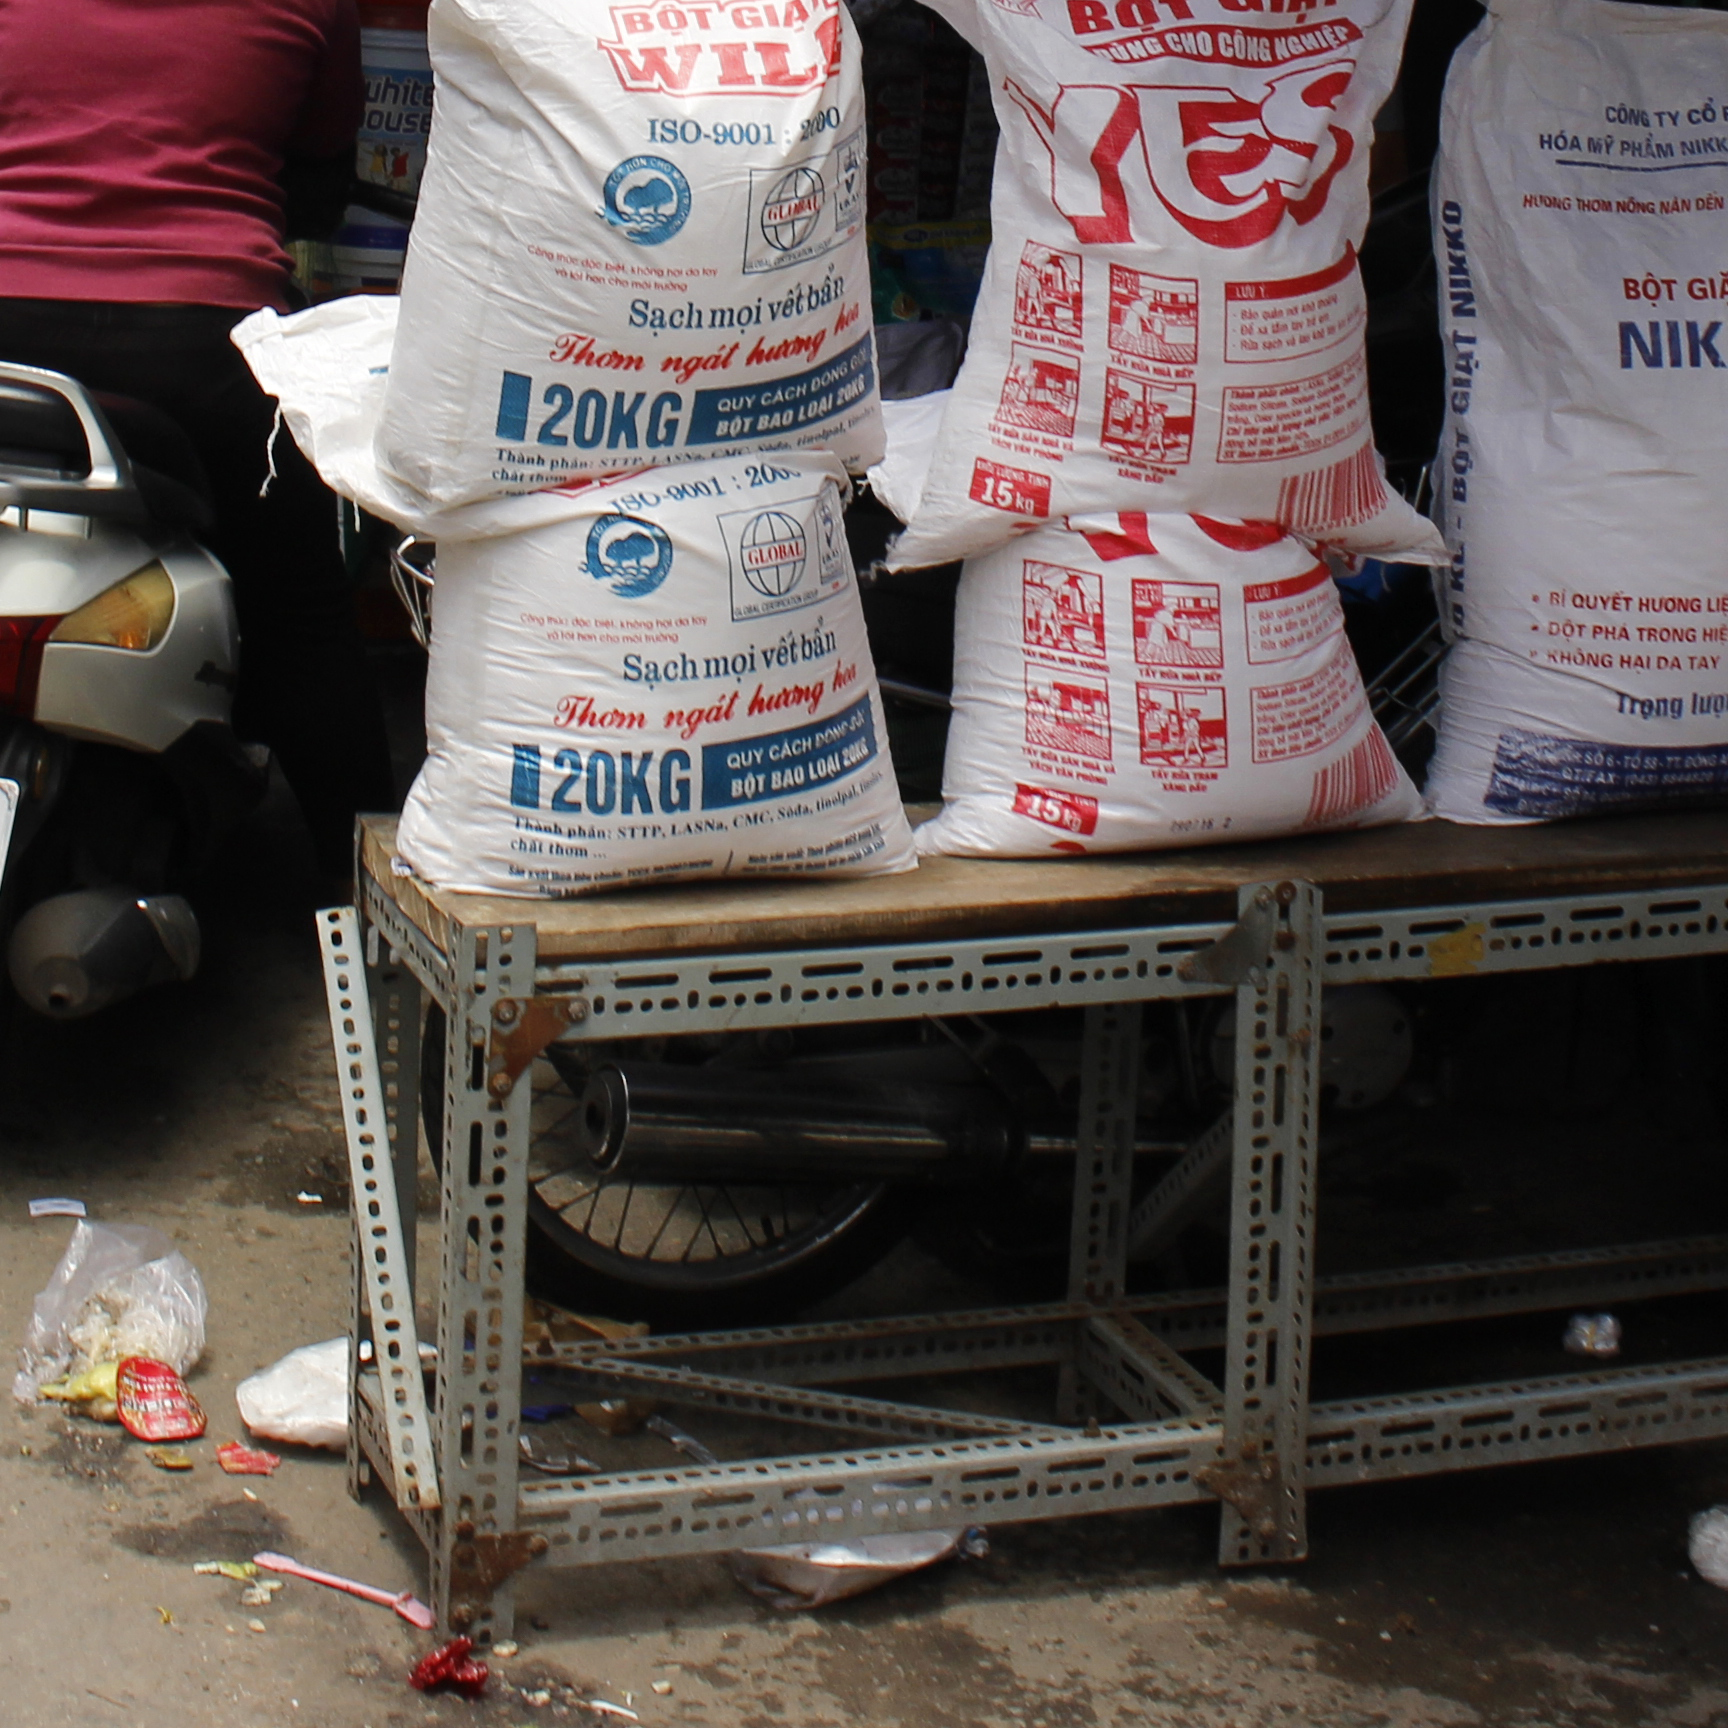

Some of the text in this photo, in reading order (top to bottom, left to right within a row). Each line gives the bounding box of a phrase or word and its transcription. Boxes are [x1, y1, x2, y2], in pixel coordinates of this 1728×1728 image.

[621, 2, 712, 36] BỘT
[1165, 26, 1349, 61] CHO CÔNG NGHIỆP
[1605, 97, 1717, 128] CÔNG TY CỔ
[647, 119, 775, 145] ISO-9001
[1539, 129, 1581, 152] HÓA
[1588, 133, 1615, 154] MỸ
[1620, 133, 1674, 159] PHẨM
[1003, 59, 1356, 249] YES
[1523, 192, 1655, 214] HƯƠNG THƠM NỒNG
[629, 263, 845, 336] Sạch mọi vết bẩn
[1623, 273, 1676, 308] BỘT
[548, 329, 826, 385] Thơm ngát hương
[1442, 200, 1478, 502] BỘT GIẶT NIKKO
[538, 382, 807, 449] 20KG QUY CÁCH
[715, 374, 865, 439] BỘT BAO LOẠI 20KG
[981, 477, 1035, 514] 15 kg
[748, 541, 804, 565] GLOBAL
[1572, 590, 1633, 612] QUYẾT
[1638, 593, 1702, 613] HƯƠNG
[1592, 622, 1631, 641] PHÁ
[1636, 627, 1698, 643] TRONG
[623, 615, 837, 690] Sạch mọi vết bẩn
[1619, 654, 1721, 675] HẠI DA TAY
[554, 680, 825, 740] Thơm ngát hương
[1618, 691, 1684, 720] Trọng
[550, 735, 813, 815] 20KG QUY CÁCH
[731, 751, 841, 801] BỘT BAO LOẠI
[1027, 794, 1062, 822] 15
[617, 824, 666, 840] STTP,
